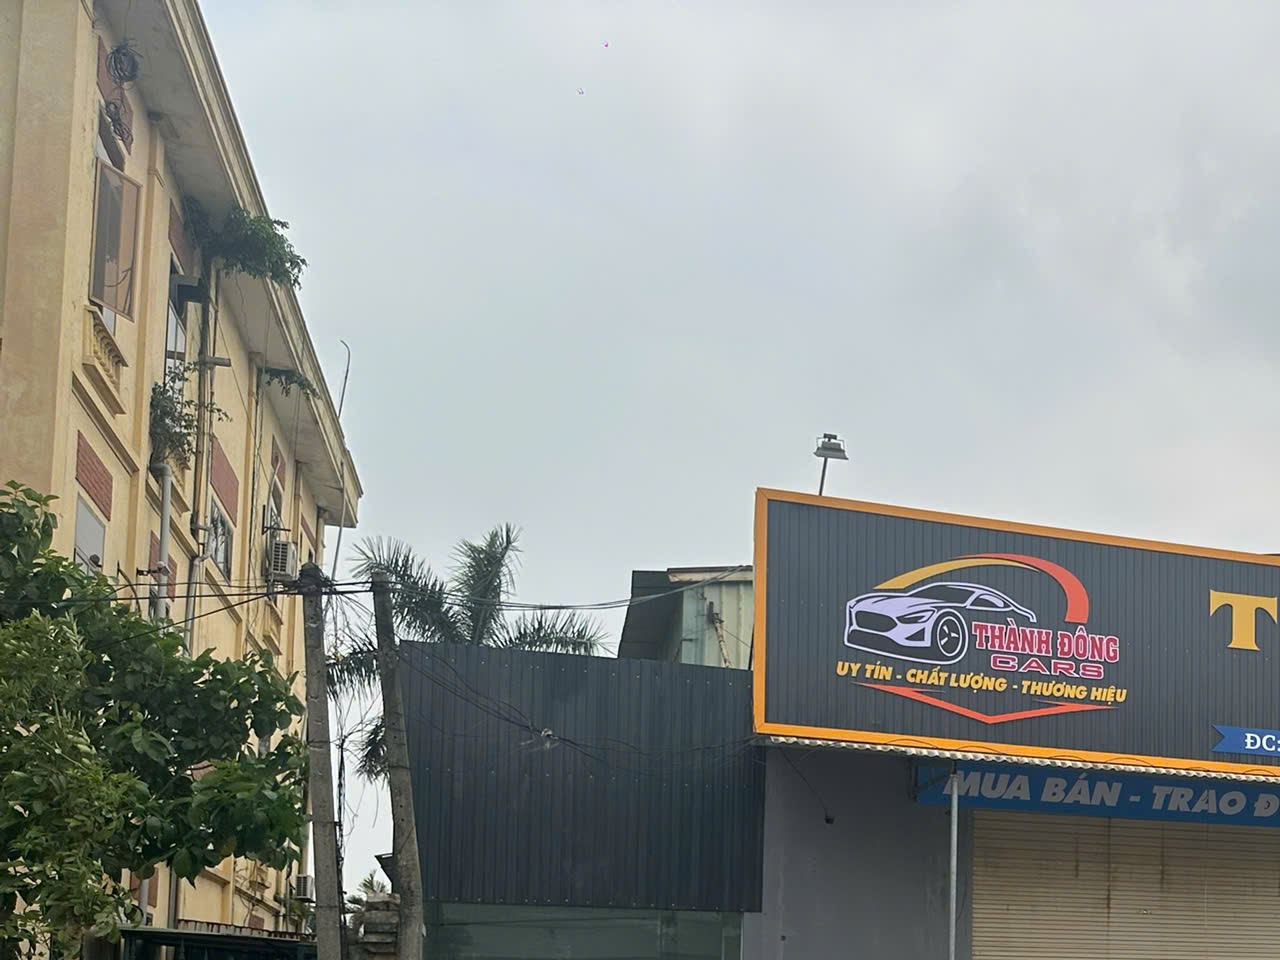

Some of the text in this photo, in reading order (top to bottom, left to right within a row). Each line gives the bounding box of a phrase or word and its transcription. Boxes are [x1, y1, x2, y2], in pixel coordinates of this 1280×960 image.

[972, 618, 1119, 662] THÀNH ĐÔNG
[836, 662, 861, 677] UY
[864, 662, 892, 680] TÍN
[906, 667, 948, 686] CHẤT
[950, 672, 1008, 694] LƯỢNG
[1021, 680, 1088, 700] THƯƠNG
[1090, 686, 1127, 705] HIỆU
[991, 654, 1104, 679] CARS
[942, 770, 1031, 801] MUA
[1041, 771, 1122, 807] BÁN
[1152, 785, 1247, 816] TRAO
